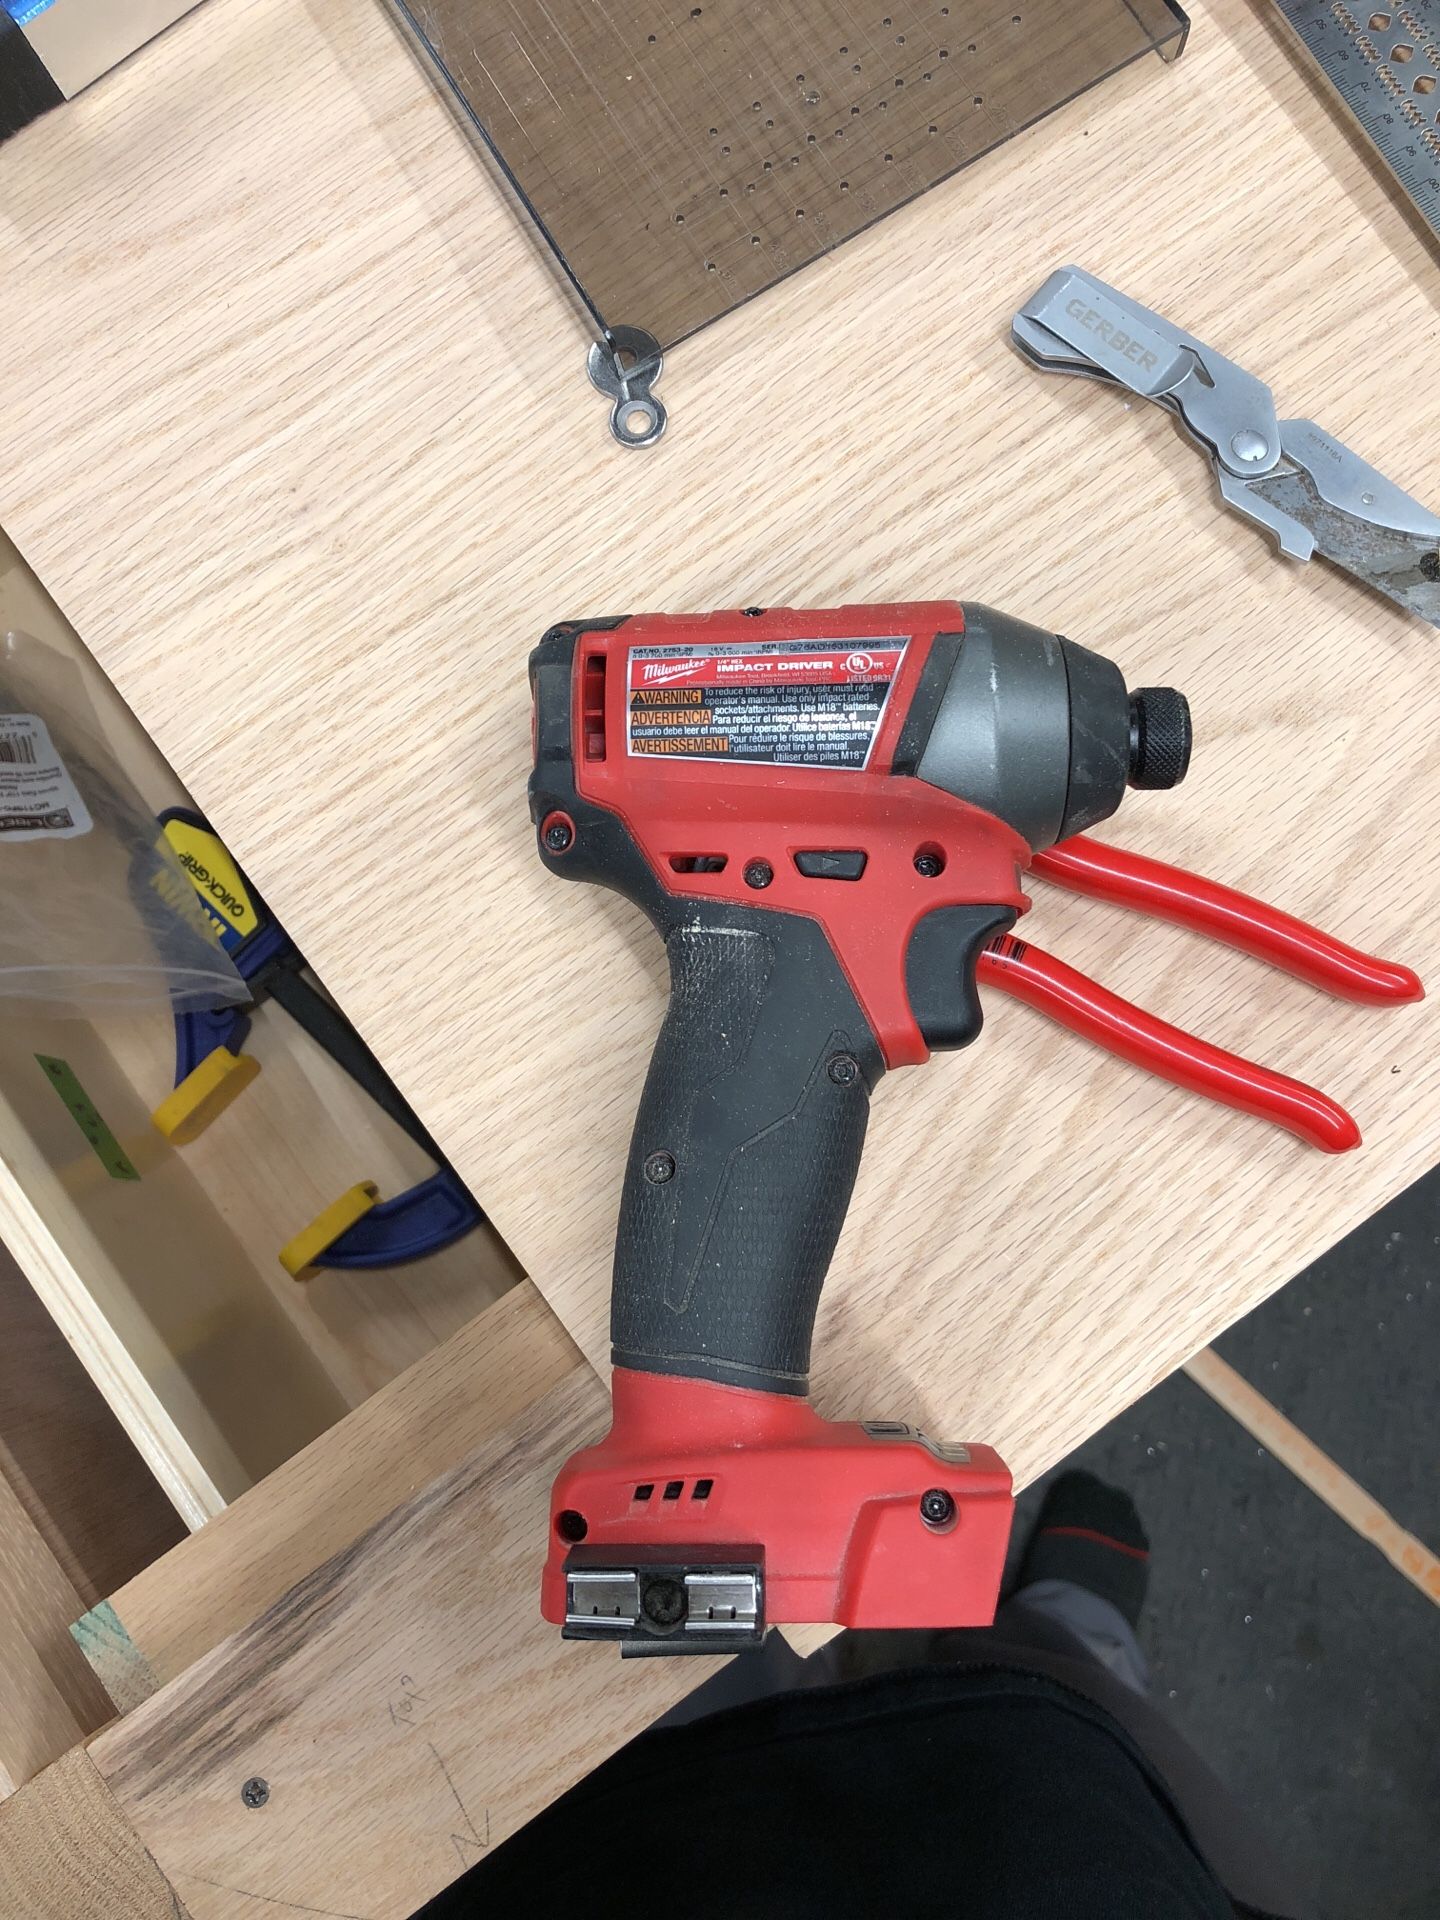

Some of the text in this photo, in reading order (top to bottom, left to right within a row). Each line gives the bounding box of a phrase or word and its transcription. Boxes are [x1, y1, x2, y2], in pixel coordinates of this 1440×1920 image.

[1338, 50, 1350, 60] 60
[1360, 81, 1372, 93] 70
[1383, 113, 1394, 125] 80
[1406, 145, 1417, 157] 90
[1065, 297, 1159, 374] GERBER
[641, 658, 706, 680] Milwaukee
[716, 661, 834, 672] IMPACT DRIVER
[644, 690, 698, 704] WARNING
[705, 688, 714, 696] To
[715, 687, 744, 696] reduce
[746, 686, 758, 694] the
[760, 686, 774, 694] risk
[777, 685, 786, 693] of
[786, 685, 812, 695] injury,
[854, 684, 874, 692] read
[704, 692, 870, 706] operator's manual. Use only impact rated
[714, 704, 800, 714] sockets/attachments.
[800, 703, 816, 712] Use
[842, 702, 880, 711] batteries.
[632, 710, 710, 724] ADVERTENCIA
[712, 712, 857, 724] Para reducir el riesgo de lesiones, el
[632, 728, 662, 736] usuario
[662, 727, 682, 736] debe
[684, 726, 699, 735] leer
[700, 726, 708, 734] el
[710, 724, 739, 734] manual
[740, 724, 752, 733] del
[754, 724, 792, 734] operador.
[792, 722, 817, 732] Utilice
[728, 732, 870, 744] Pour réduire le risque de blessures,
[632, 738, 726, 752] AVERTISSEMENT
[728, 743, 774, 754] l'utilisateur
[776, 743, 792, 752] doit
[792, 742, 806, 752] lire
[808, 742, 816, 751] le
[774, 752, 802, 762] Utiliser
[804, 752, 818, 760] des
[820, 752, 840, 762] piles
[179, 851, 245, 918] QUICK-GRIP
